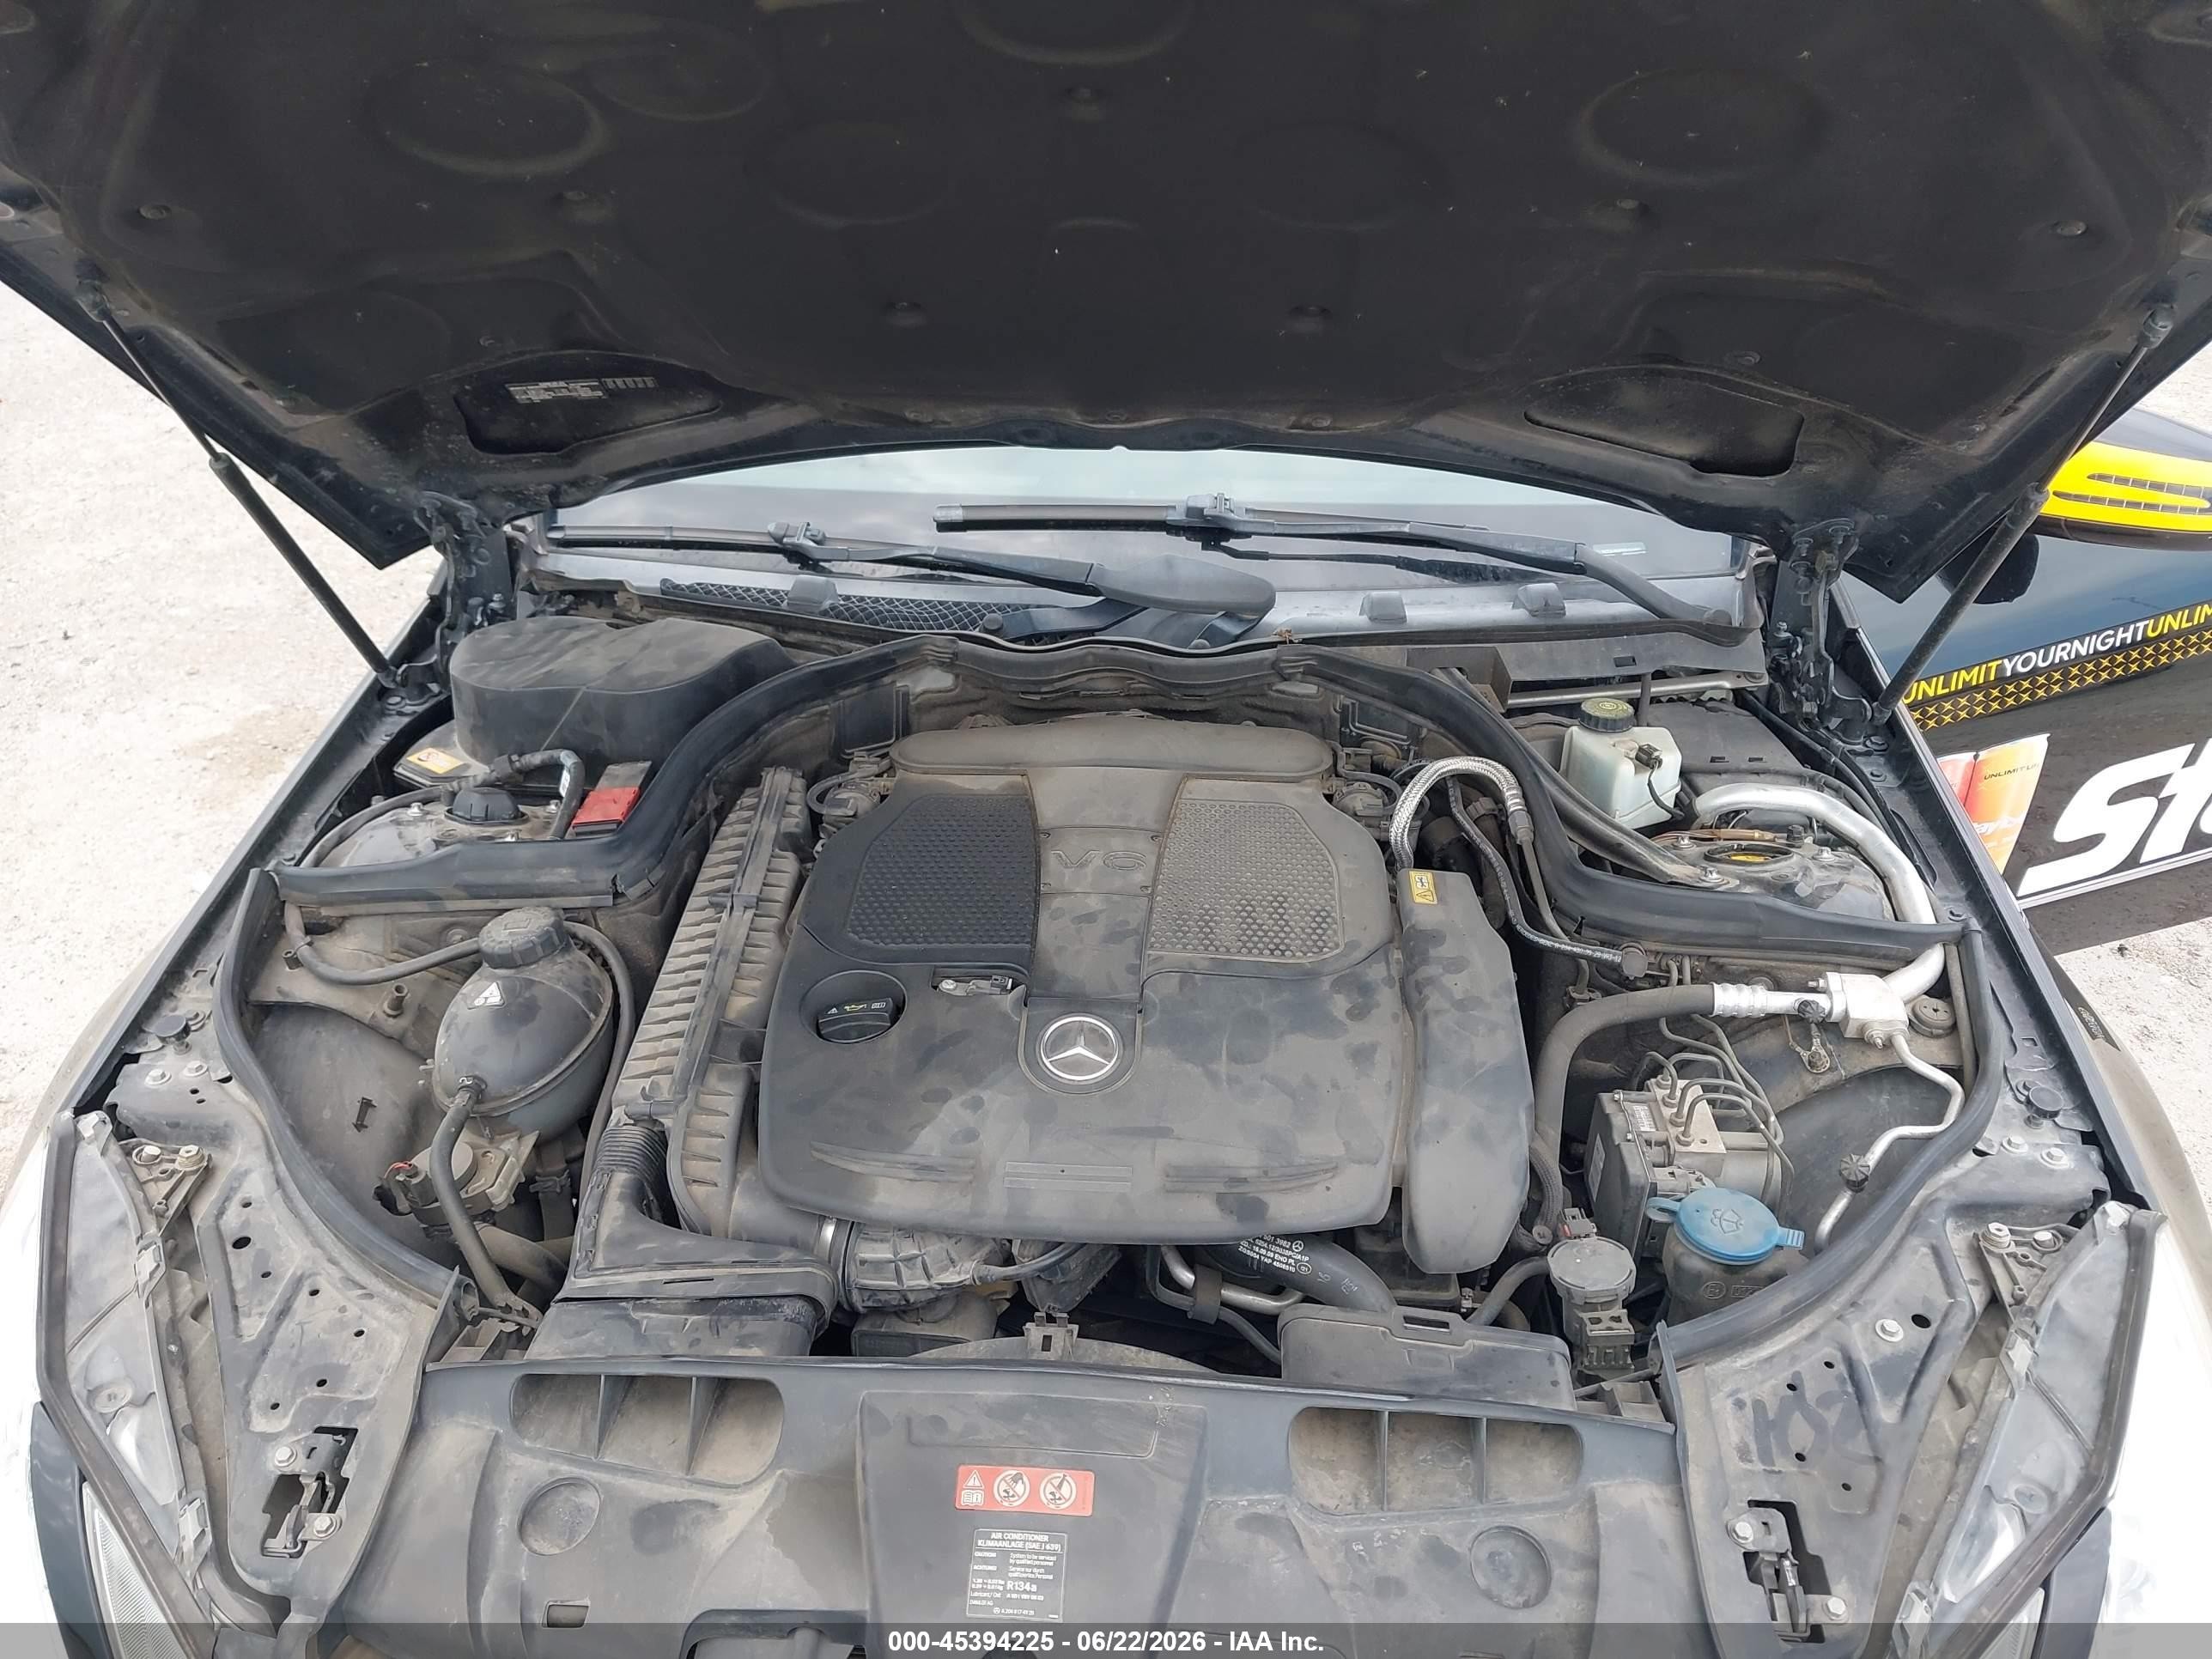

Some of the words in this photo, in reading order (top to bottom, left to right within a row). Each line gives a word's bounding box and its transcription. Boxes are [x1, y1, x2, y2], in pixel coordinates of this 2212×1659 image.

[1050, 849, 1147, 871] V6
[1003, 1533, 1049, 1542] CONDITIONER
[977, 1539, 1024, 1549] KLIMAANLAGE
[1006, 1580, 1037, 1593] R134a
